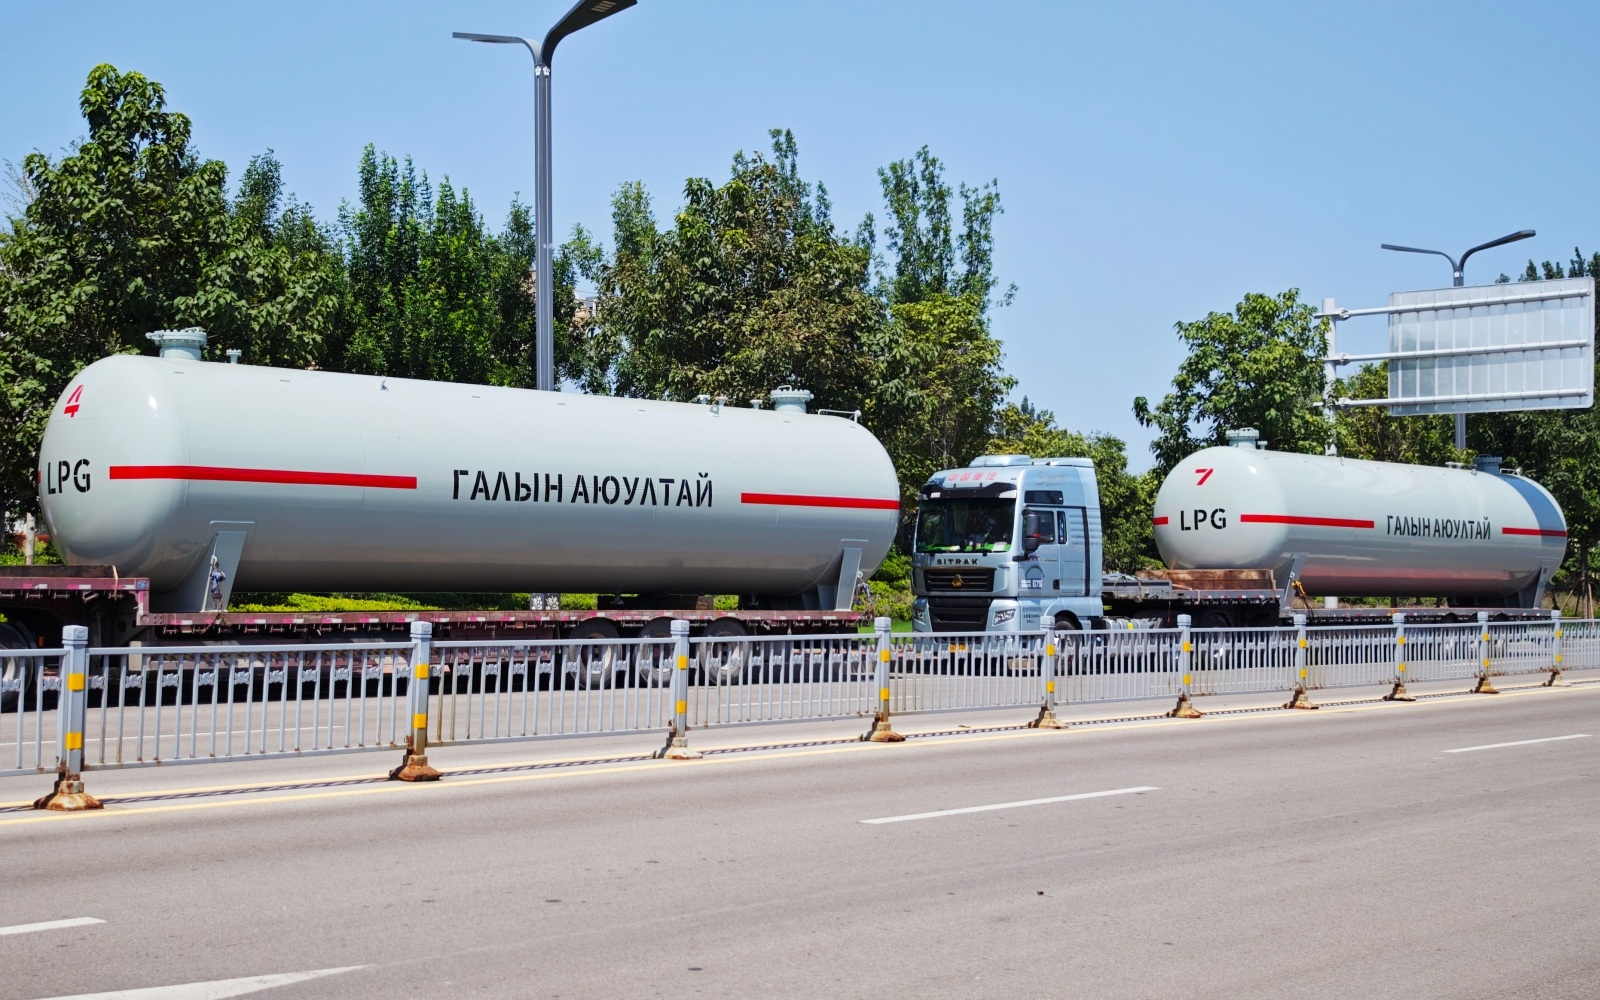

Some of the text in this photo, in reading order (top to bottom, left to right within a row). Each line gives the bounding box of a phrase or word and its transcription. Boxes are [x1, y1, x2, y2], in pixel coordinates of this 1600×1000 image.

[64, 384, 83, 418] 4
[48, 458, 91, 495] LPG
[452, 469, 713, 508] ГАЛЫН АЮУЛТАЙ
[1195, 468, 1214, 486] 7
[1180, 507, 1227, 531] LPG
[1386, 514, 1491, 541] ГАЛЫН АЮУЛТАЙ
[936, 558, 979, 566] SITRAK
